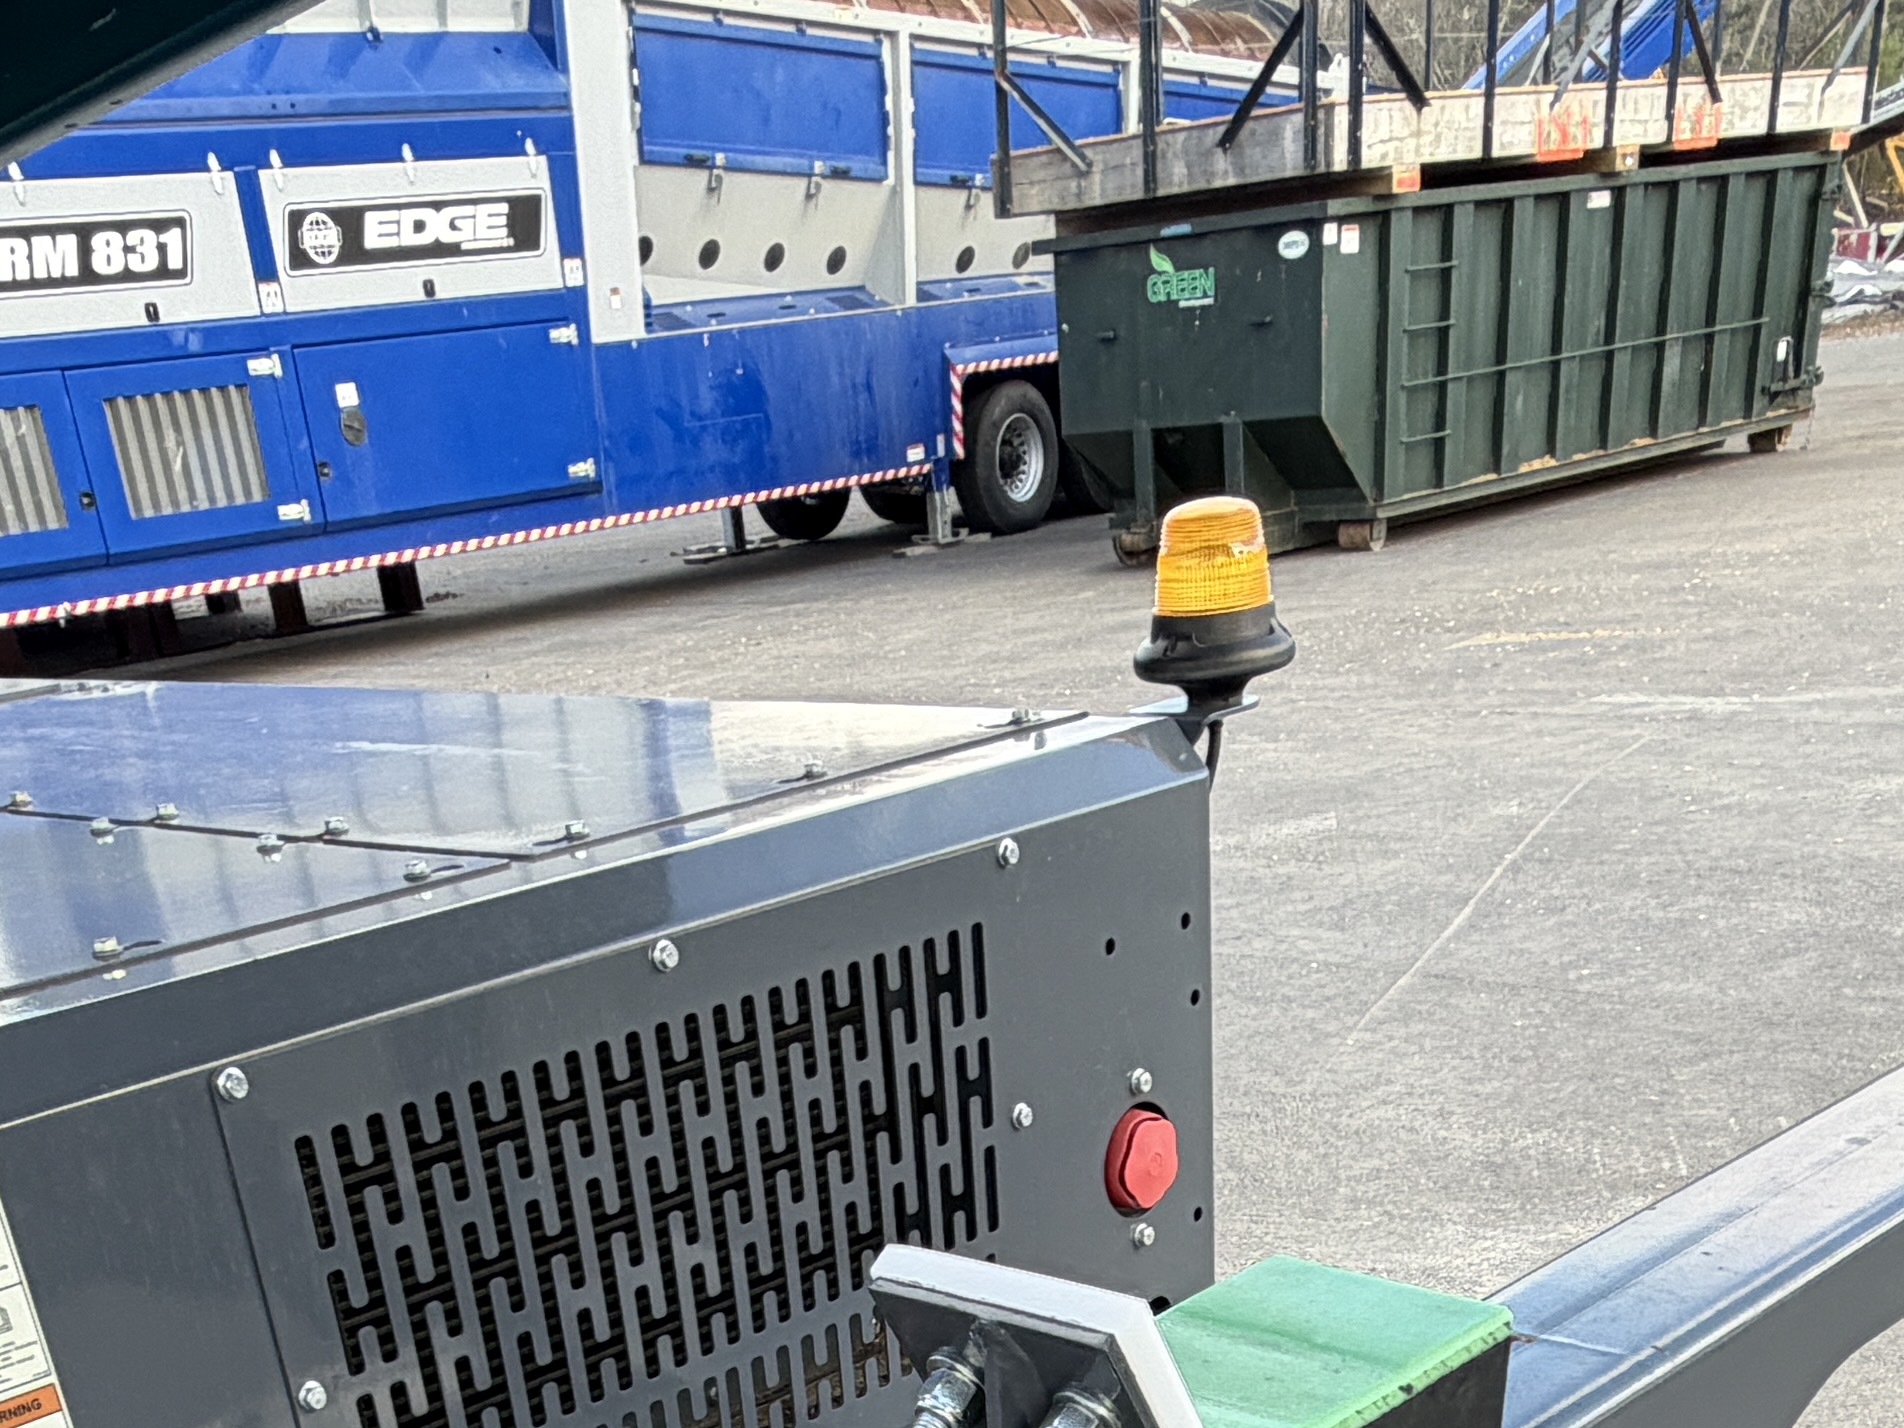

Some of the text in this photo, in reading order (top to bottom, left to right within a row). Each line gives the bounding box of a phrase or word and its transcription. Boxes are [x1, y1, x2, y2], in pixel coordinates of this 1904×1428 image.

[363, 202, 510, 250] EDGE
[90, 226, 184, 276] 831
[1146, 266, 1216, 303] GREEN
